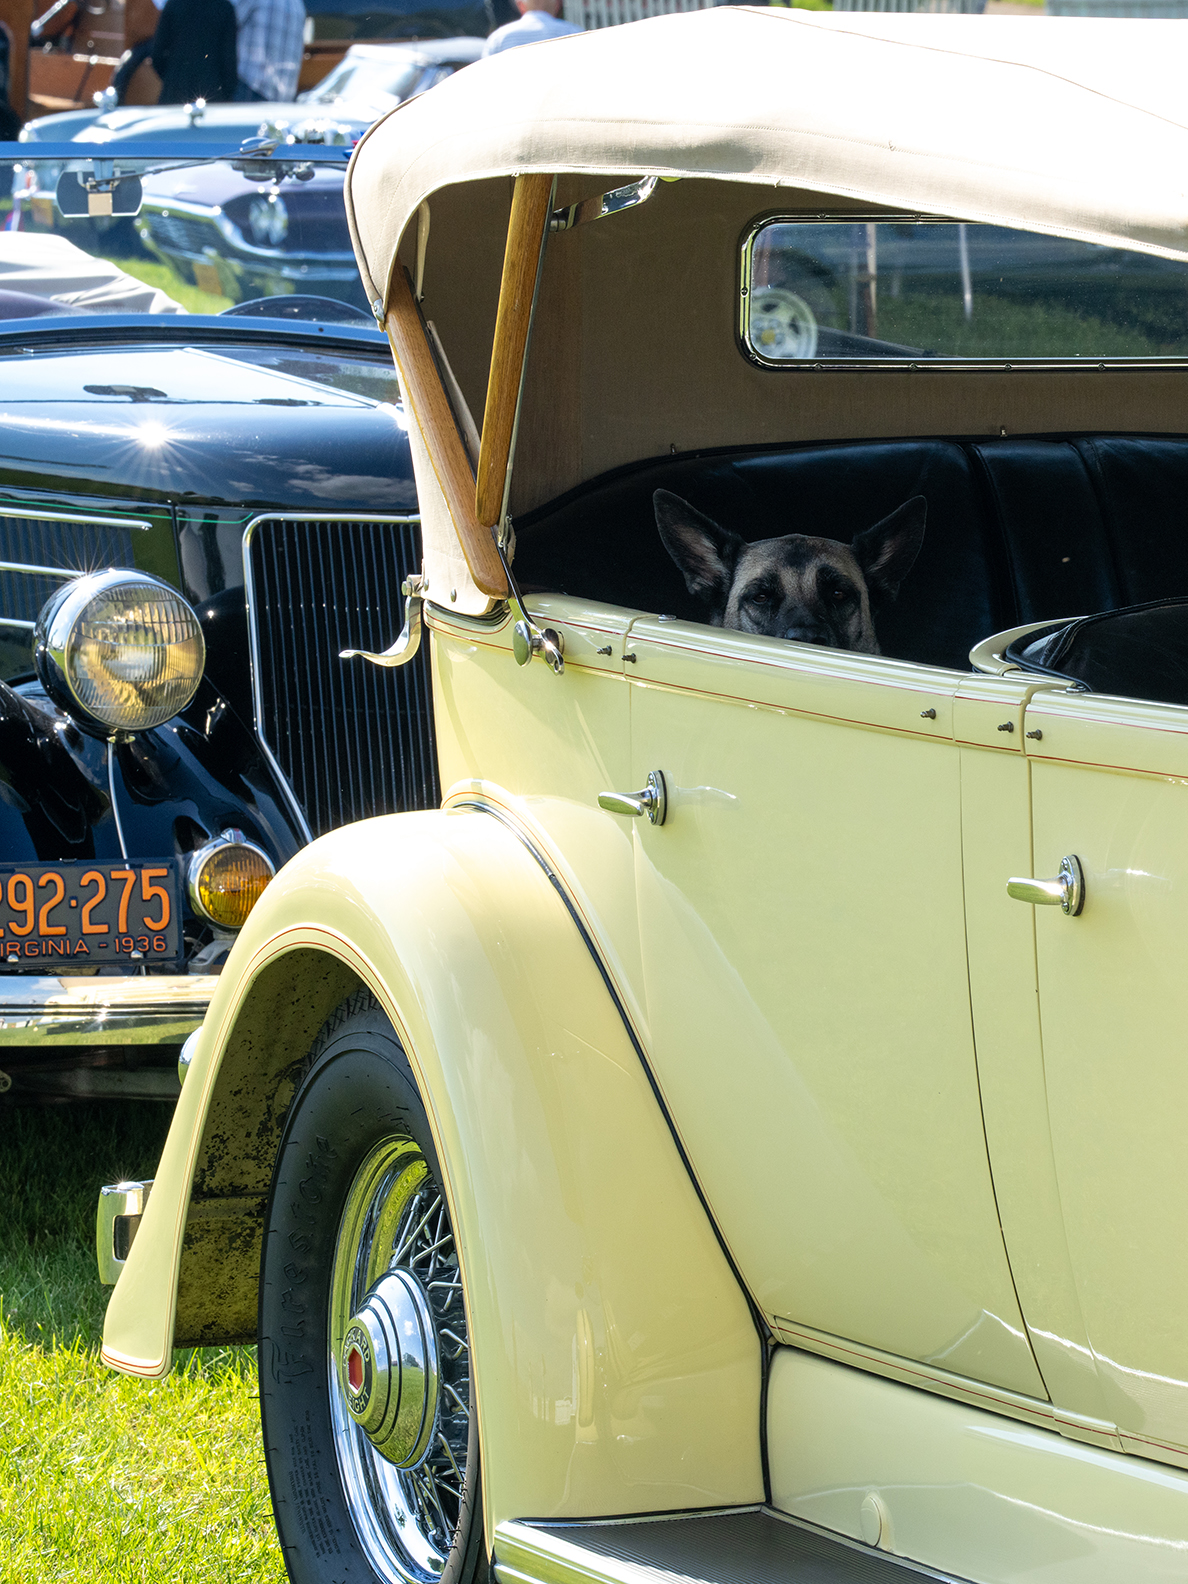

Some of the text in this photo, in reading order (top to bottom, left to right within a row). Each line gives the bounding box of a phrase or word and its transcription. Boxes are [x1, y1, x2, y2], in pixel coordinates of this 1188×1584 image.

[0, 939, 89, 957] IRGINIA
[115, 935, 166, 953] 1936
[348, 1387, 370, 1412] EIGHT
